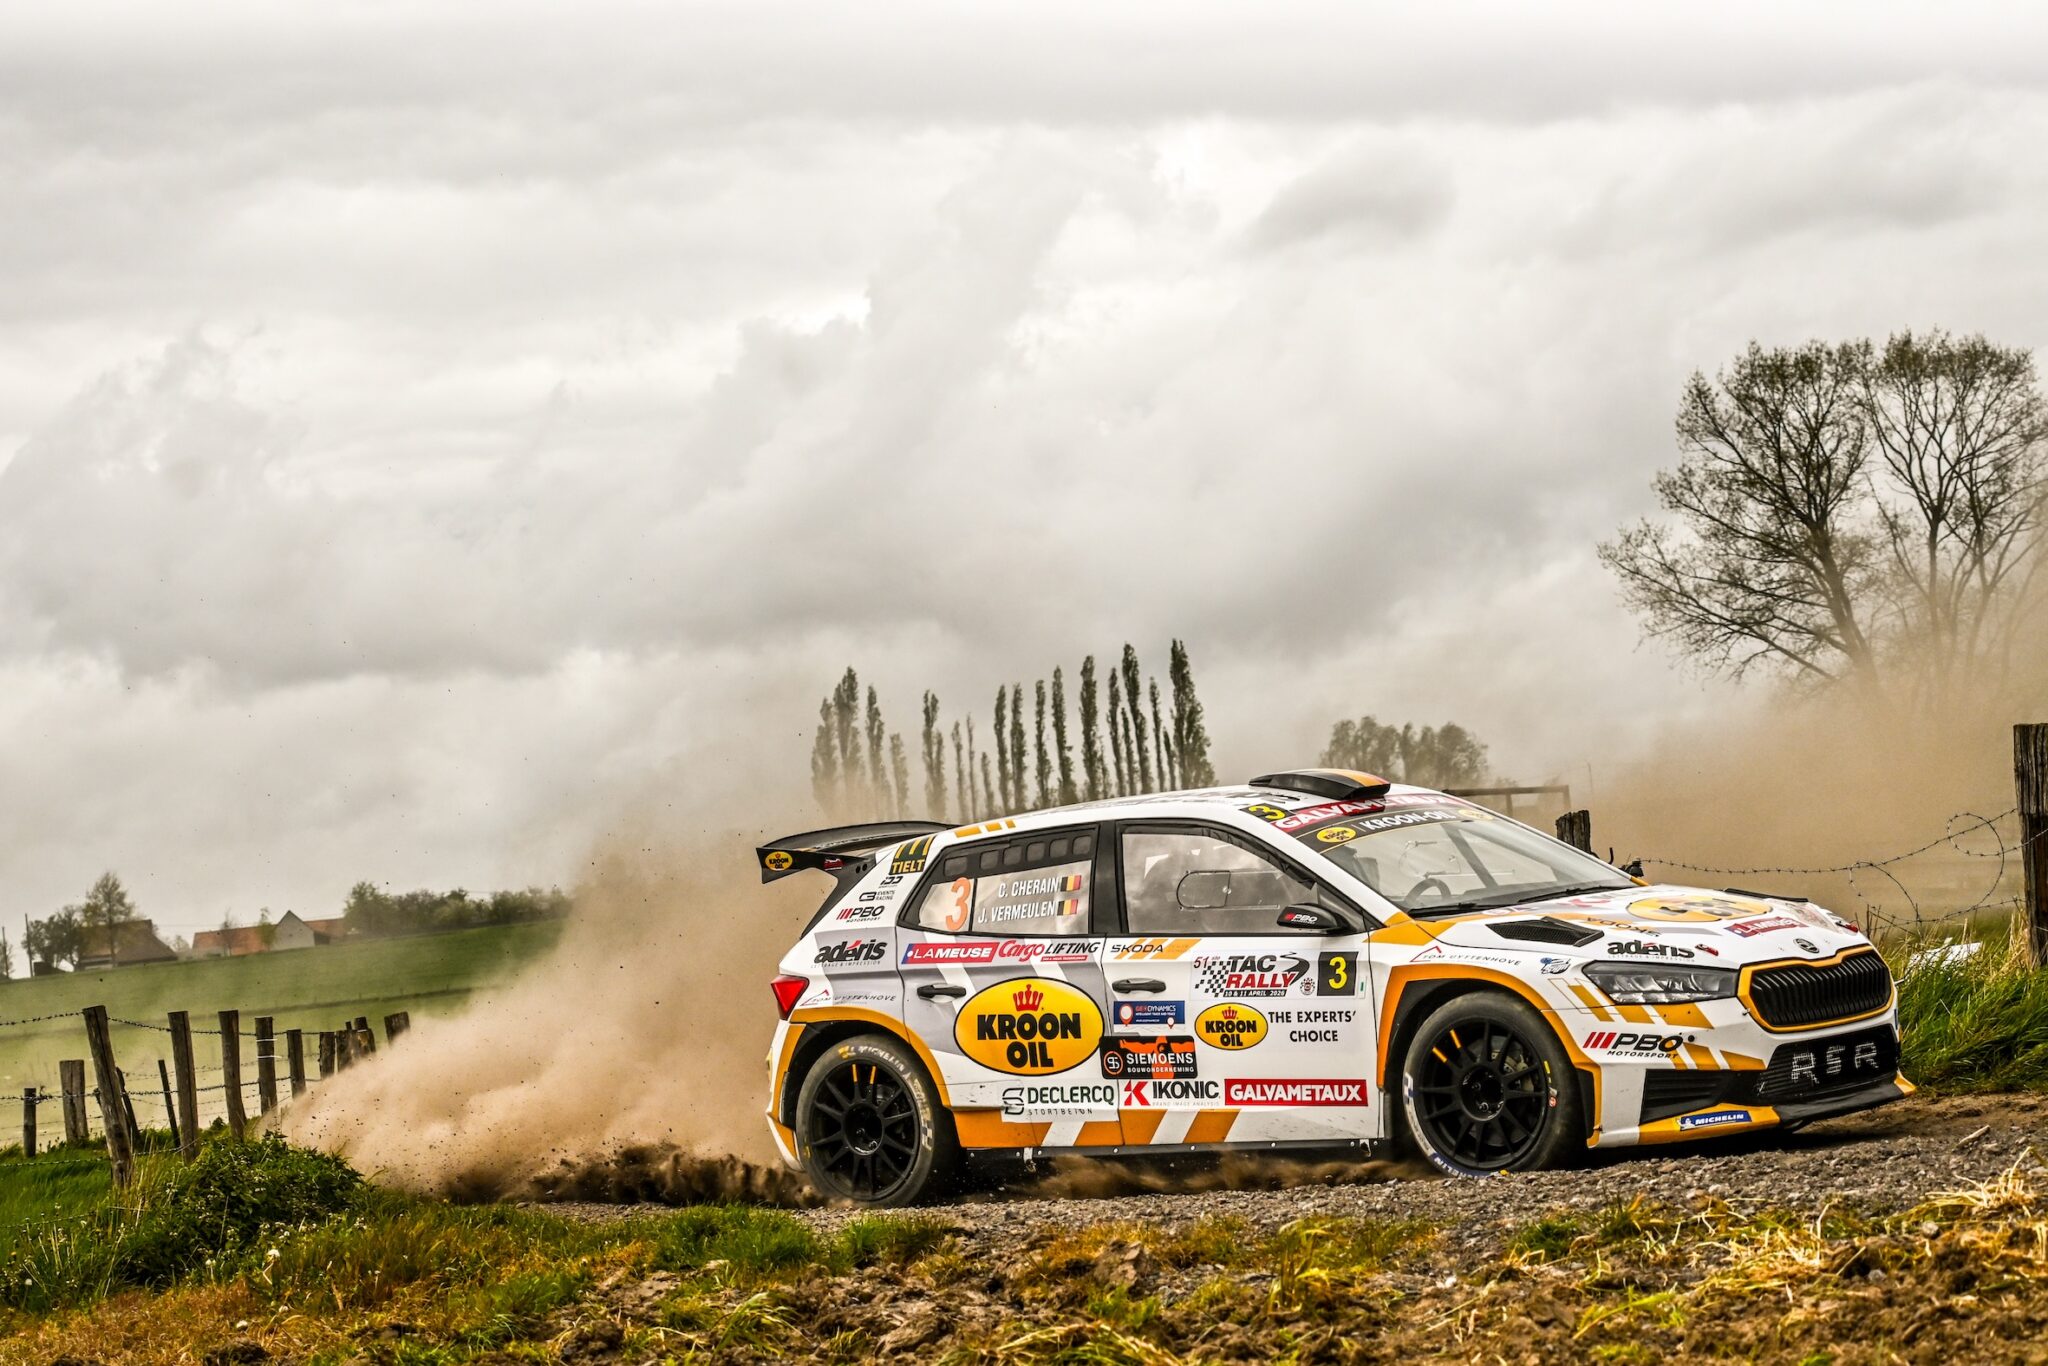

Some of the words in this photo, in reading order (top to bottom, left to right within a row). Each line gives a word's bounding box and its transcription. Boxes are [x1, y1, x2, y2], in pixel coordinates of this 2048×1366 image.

[1248, 805, 1286, 820] 3
[892, 859, 925, 874] TIELT
[998, 883, 1009, 898] C.
[1011, 877, 1059, 896] CHERAIN
[851, 905, 885, 918] PBO
[945, 876, 971, 931] 3
[978, 909, 988, 924] J.
[991, 901, 1057, 922] VERMEULEN
[998, 940, 1046, 962] Cargo
[1044, 941, 1101, 956] LIFTING
[1228, 955, 1277, 973] TAC
[1328, 956, 1349, 990] 3
[1225, 972, 1297, 989] RALLY
[1268, 1011, 1292, 1023] THE
[977, 1013, 1082, 1041] KROON
[1205, 1020, 1257, 1033] KROON
[1220, 1033, 1243, 1047] OIL
[1289, 1030, 1339, 1042] CHOICE
[1611, 1033, 1684, 1052] PBO
[1006, 1041, 1054, 1068] OIL
[1126, 1053, 1194, 1065] SIEMOENS
[1606, 1050, 1678, 1059] MOTORSPORT
[1027, 1085, 1115, 1106] DECLERCQ
[1153, 1080, 1220, 1099] IKONIC
[1230, 1084, 1362, 1102] GALVAMETAUX
[1695, 1113, 1744, 1125] MICHELIN
